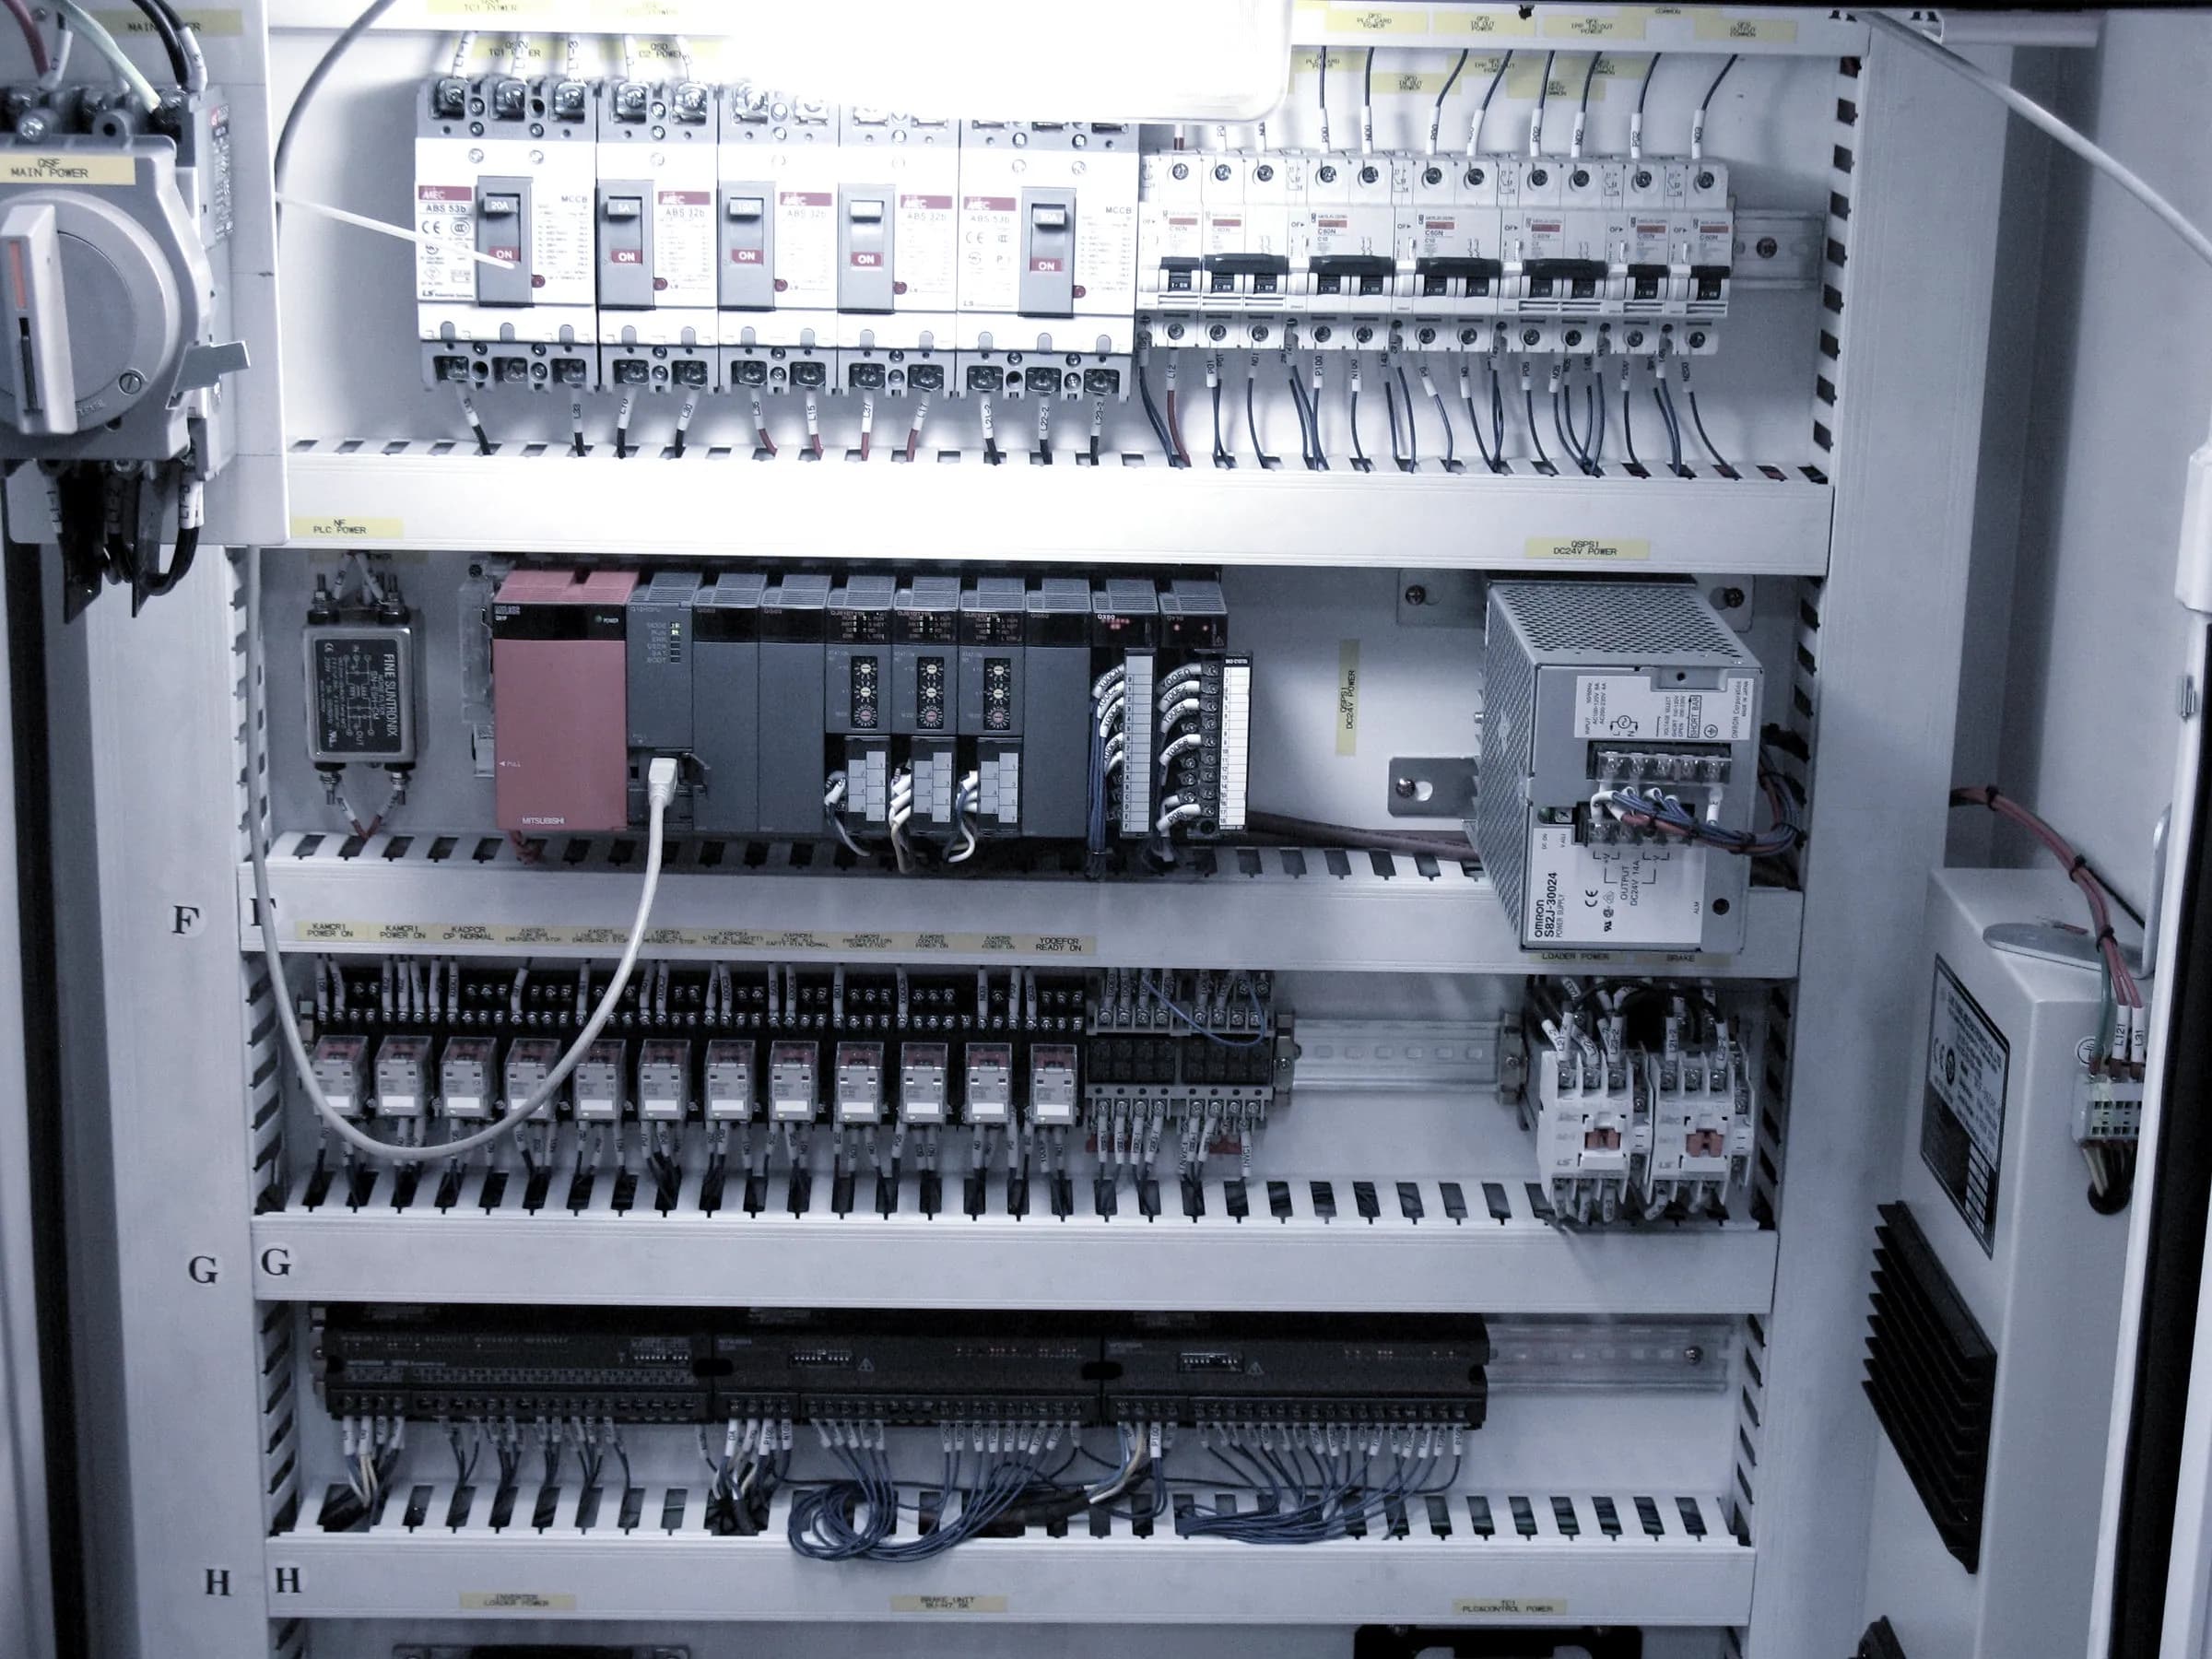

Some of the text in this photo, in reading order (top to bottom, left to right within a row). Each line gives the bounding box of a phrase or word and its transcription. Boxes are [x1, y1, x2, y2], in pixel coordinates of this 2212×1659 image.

[1574, 128, 1583, 146] N02
[11, 169, 88, 178] MAIN POWER
[490, 201, 509, 210] 20A
[560, 195, 588, 204] MCCB
[426, 205, 466, 214] ABS 53b
[665, 209, 685, 218] ABS
[787, 209, 806, 218] ABS
[907, 212, 926, 221] ABS
[1106, 206, 1133, 215] MCCB
[970, 215, 989, 223] ABS
[496, 250, 513, 260] ON
[618, 252, 636, 262] ON
[738, 251, 755, 261] ON
[857, 254, 875, 265] ON
[1038, 261, 1055, 271] ON
[1206, 359, 1216, 375] P01
[1251, 351, 1261, 367] N01
[1314, 354, 1324, 377] P100
[1169, 363, 1178, 380] L12
[1350, 358, 1359, 380] N100
[681, 403, 694, 420] L30
[985, 404, 994, 430] L21-2
[1041, 406, 1051, 432] L22-2
[336, 526, 367, 535] POWER
[383, 653, 398, 737] FINE SUNTRONIX
[1346, 669, 1356, 730] DC24V POWER
[1689, 697, 1700, 737] SHORT BAR
[1731, 680, 1742, 738] OMRON Corporation
[355, 730, 364, 746] OUT
[522, 817, 565, 825] MITSUBISHI
[1620, 865, 1630, 900] OUTPUT
[1630, 859, 1641, 906] DC24V 14A
[1544, 872, 1558, 938] S82J-30024
[1557, 894, 1566, 915] SUPPLY
[1585, 888, 1599, 908] CE
[171, 905, 200, 935] F
[413, 932, 426, 940] ON
[459, 933, 494, 941] NORMAL
[1036, 944, 1065, 952] READY
[1666, 954, 1695, 963] BRAKE
[2115, 1023, 2125, 1047] L121
[2135, 1029, 2145, 1047] L31
[189, 1255, 218, 1284] G
[262, 1248, 291, 1276] G
[206, 1569, 232, 1596] H
[276, 1567, 302, 1594] H
